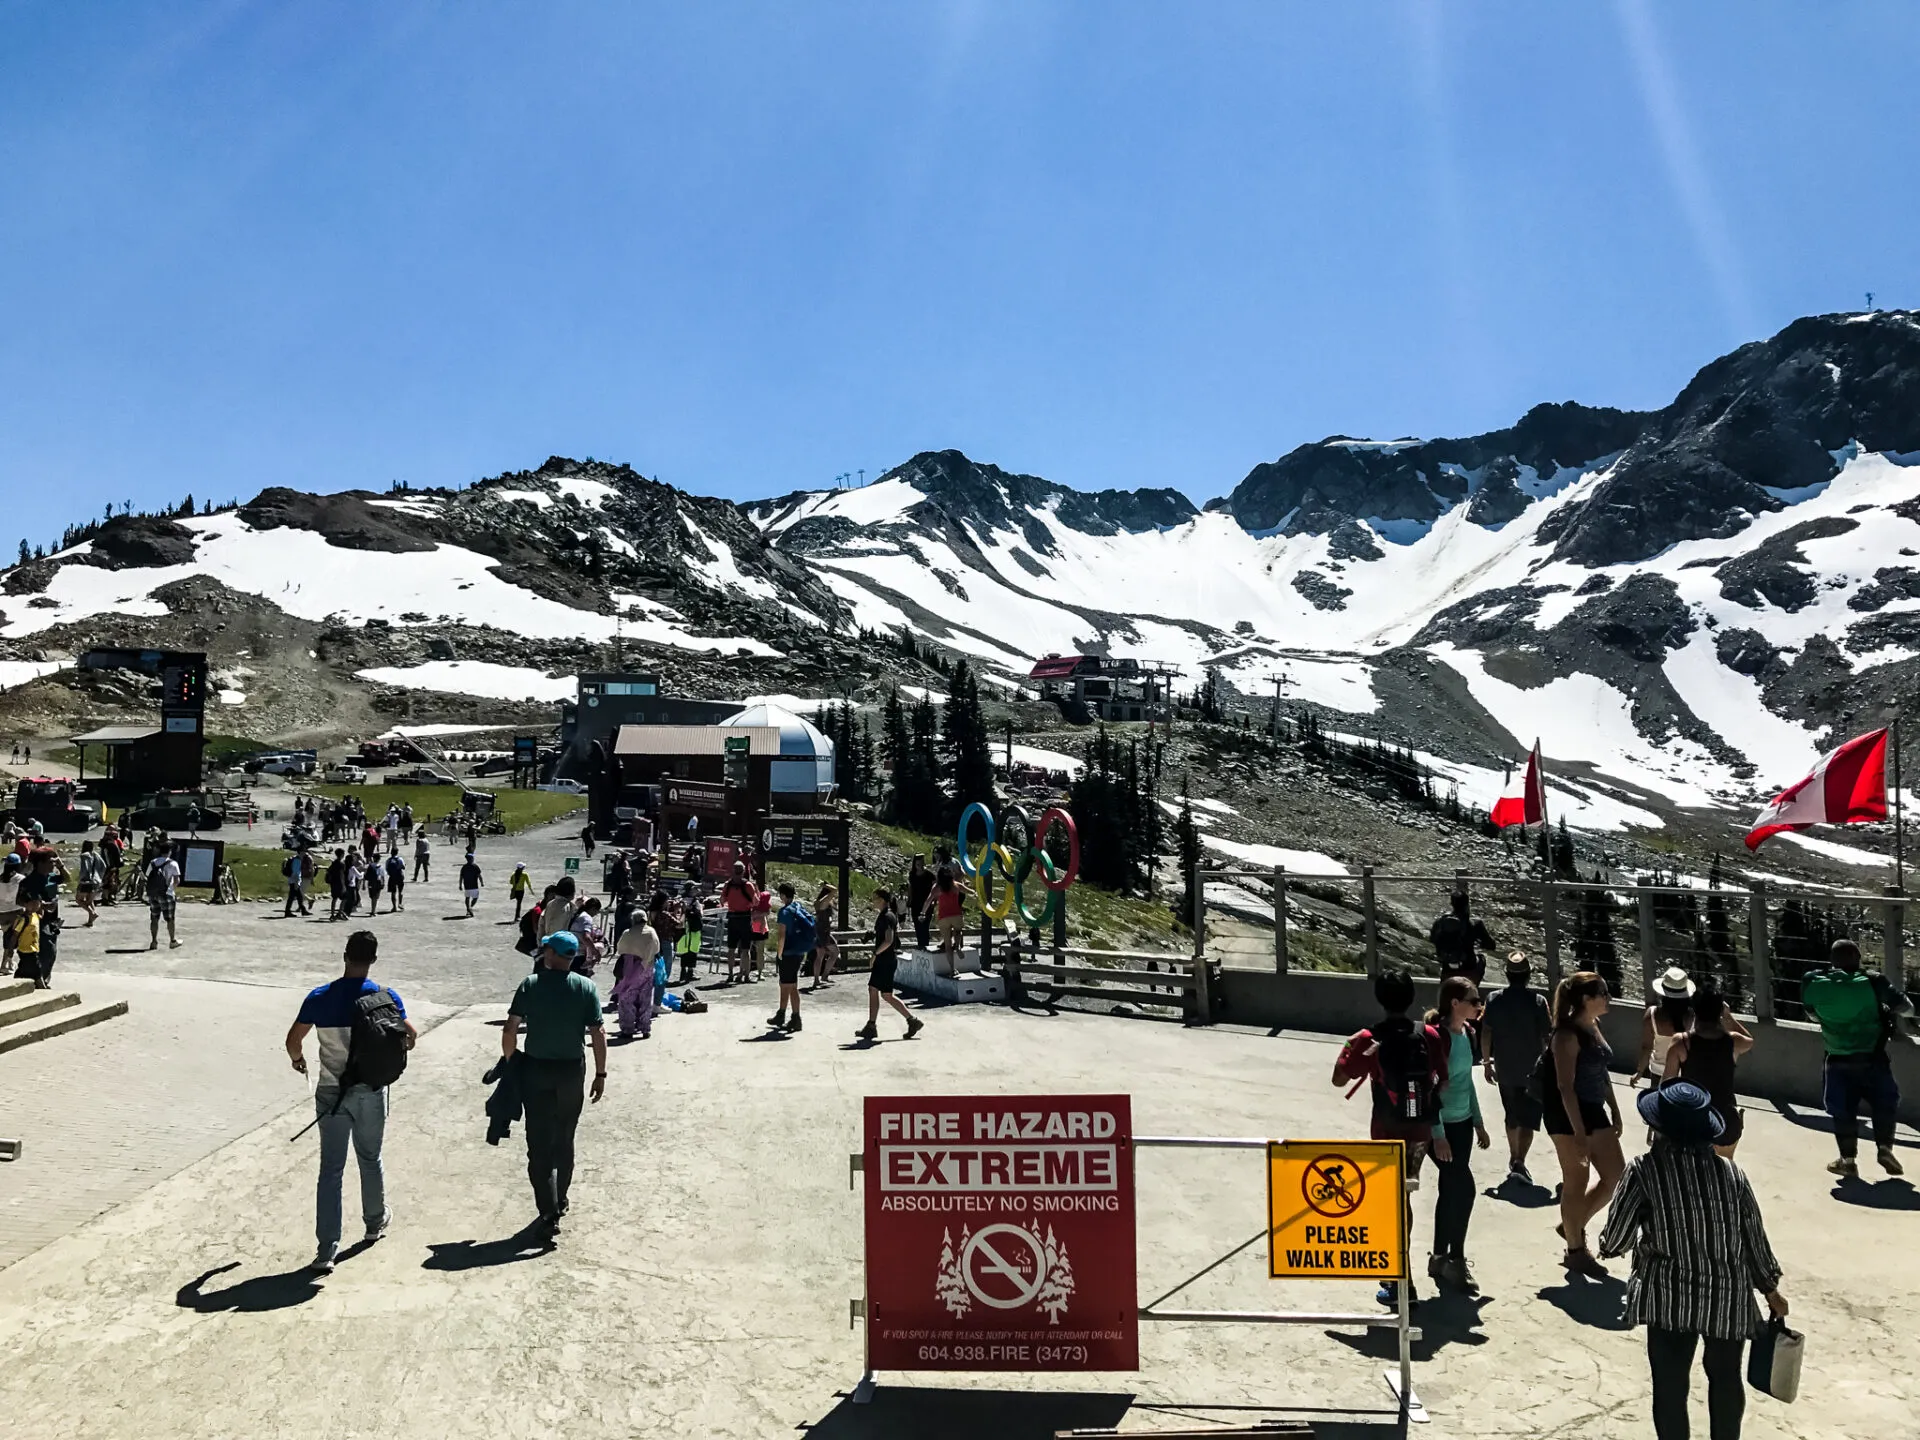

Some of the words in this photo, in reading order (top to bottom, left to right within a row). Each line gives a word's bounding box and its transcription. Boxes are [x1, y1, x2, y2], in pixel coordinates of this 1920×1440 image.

[880, 1112, 960, 1139] FIRE
[973, 1111, 1117, 1139] HAZARD
[888, 1150, 1112, 1185] EXTREME
[881, 1195, 995, 1212] ABSOLUTELY
[1000, 1195, 1028, 1212] NO
[1033, 1195, 1120, 1212] SMOKING
[1305, 1225, 1369, 1245] PLEASE
[1286, 1250, 1335, 1269] WALK
[1340, 1251, 1390, 1269] BIKES
[883, 1329, 890, 1340] IF
[892, 1329, 907, 1340] YOU
[909, 1329, 929, 1340] SPOT
[930, 1329, 937, 1340] A
[938, 1329, 955, 1340] FIRE
[956, 1329, 984, 1340] PLEASE
[986, 1329, 1013, 1340] NOTIFY
[1014, 1329, 1029, 1340] THE
[1030, 1329, 1045, 1340] LIFT
[1047, 1331, 1090, 1340] ATTENDANT
[1091, 1331, 1103, 1340] OR
[1105, 1331, 1124, 1340] CALL
[918, 1345, 1030, 1361] 604.938.FIRE
[1036, 1345, 1089, 1364] (3473)
